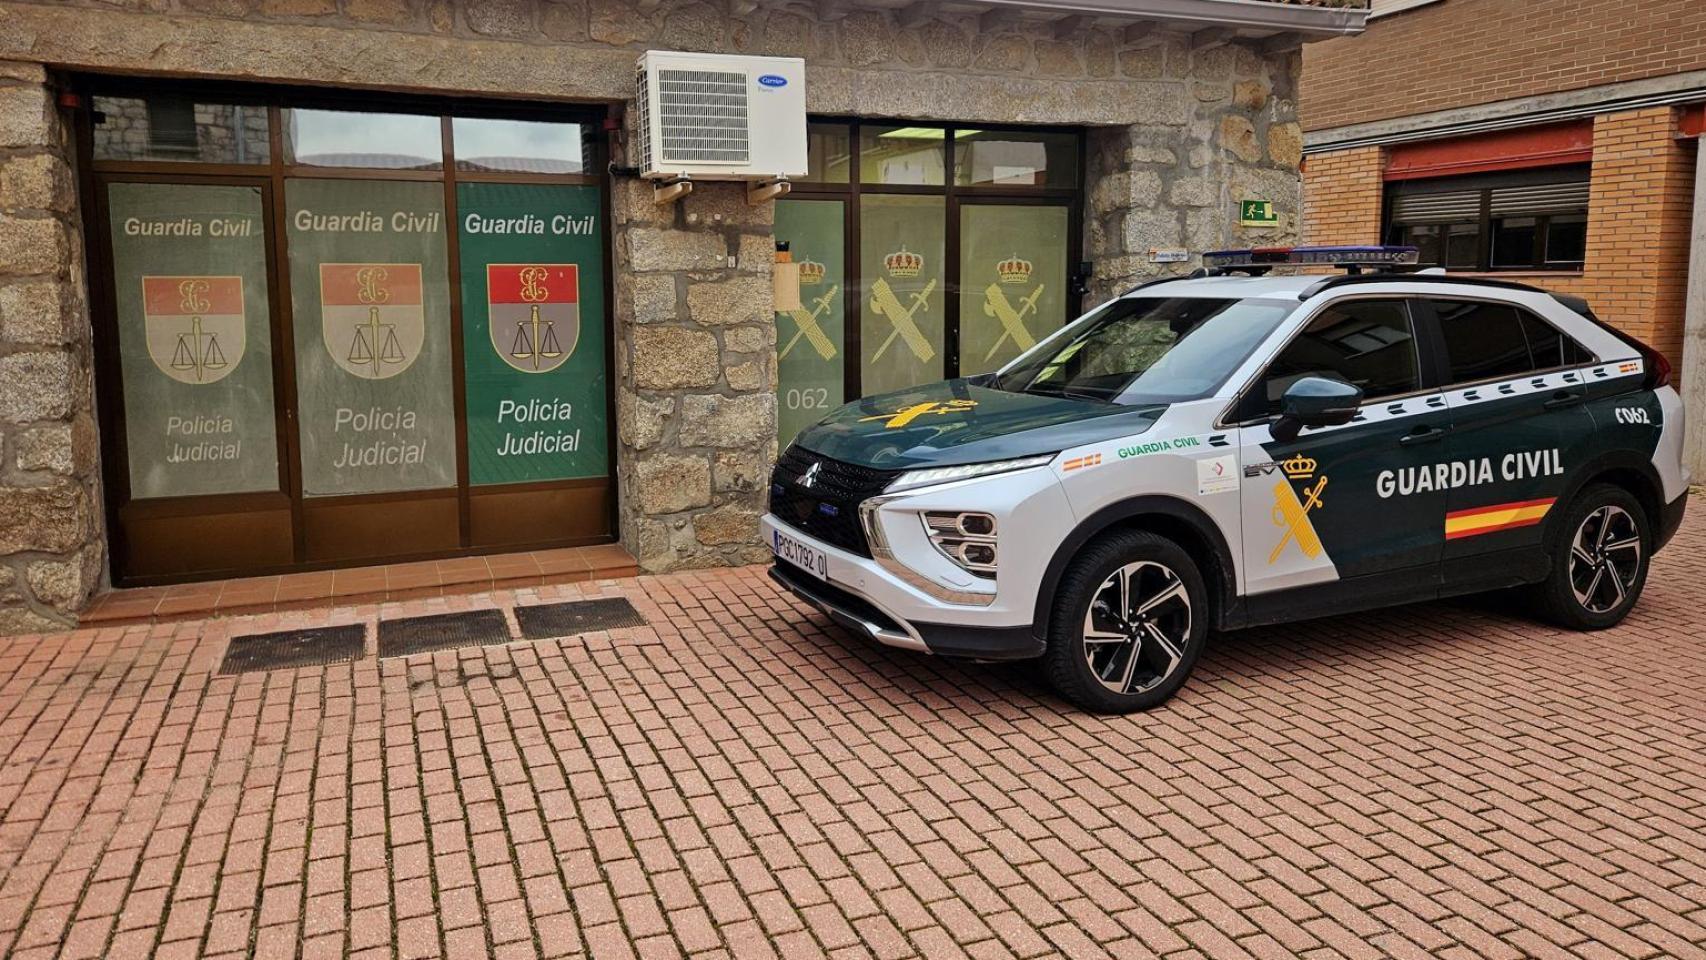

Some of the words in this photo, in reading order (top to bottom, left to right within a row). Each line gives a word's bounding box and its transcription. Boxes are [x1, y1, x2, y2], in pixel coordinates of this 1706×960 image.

[125, 218, 202, 236] Guardia
[209, 219, 251, 237] Civil
[294, 209, 383, 232] Guardia
[391, 211, 439, 233] Civil
[465, 213, 545, 234] Guardia
[551, 214, 595, 235] Civil
[497, 398, 572, 423] Policía
[787, 388, 829, 409] 062
[166, 414, 232, 436] Policía
[335, 406, 416, 432] Policía
[166, 440, 241, 463] Judicial
[333, 438, 426, 468] Judicial
[497, 428, 580, 456] Judicial
[1118, 441, 1171, 459] GUARDIA
[1173, 437, 1200, 448] CIVIL
[1376, 457, 1494, 499] GUARDIA
[1501, 448, 1564, 481] CIVIL
[778, 534, 814, 571] PGC1792
